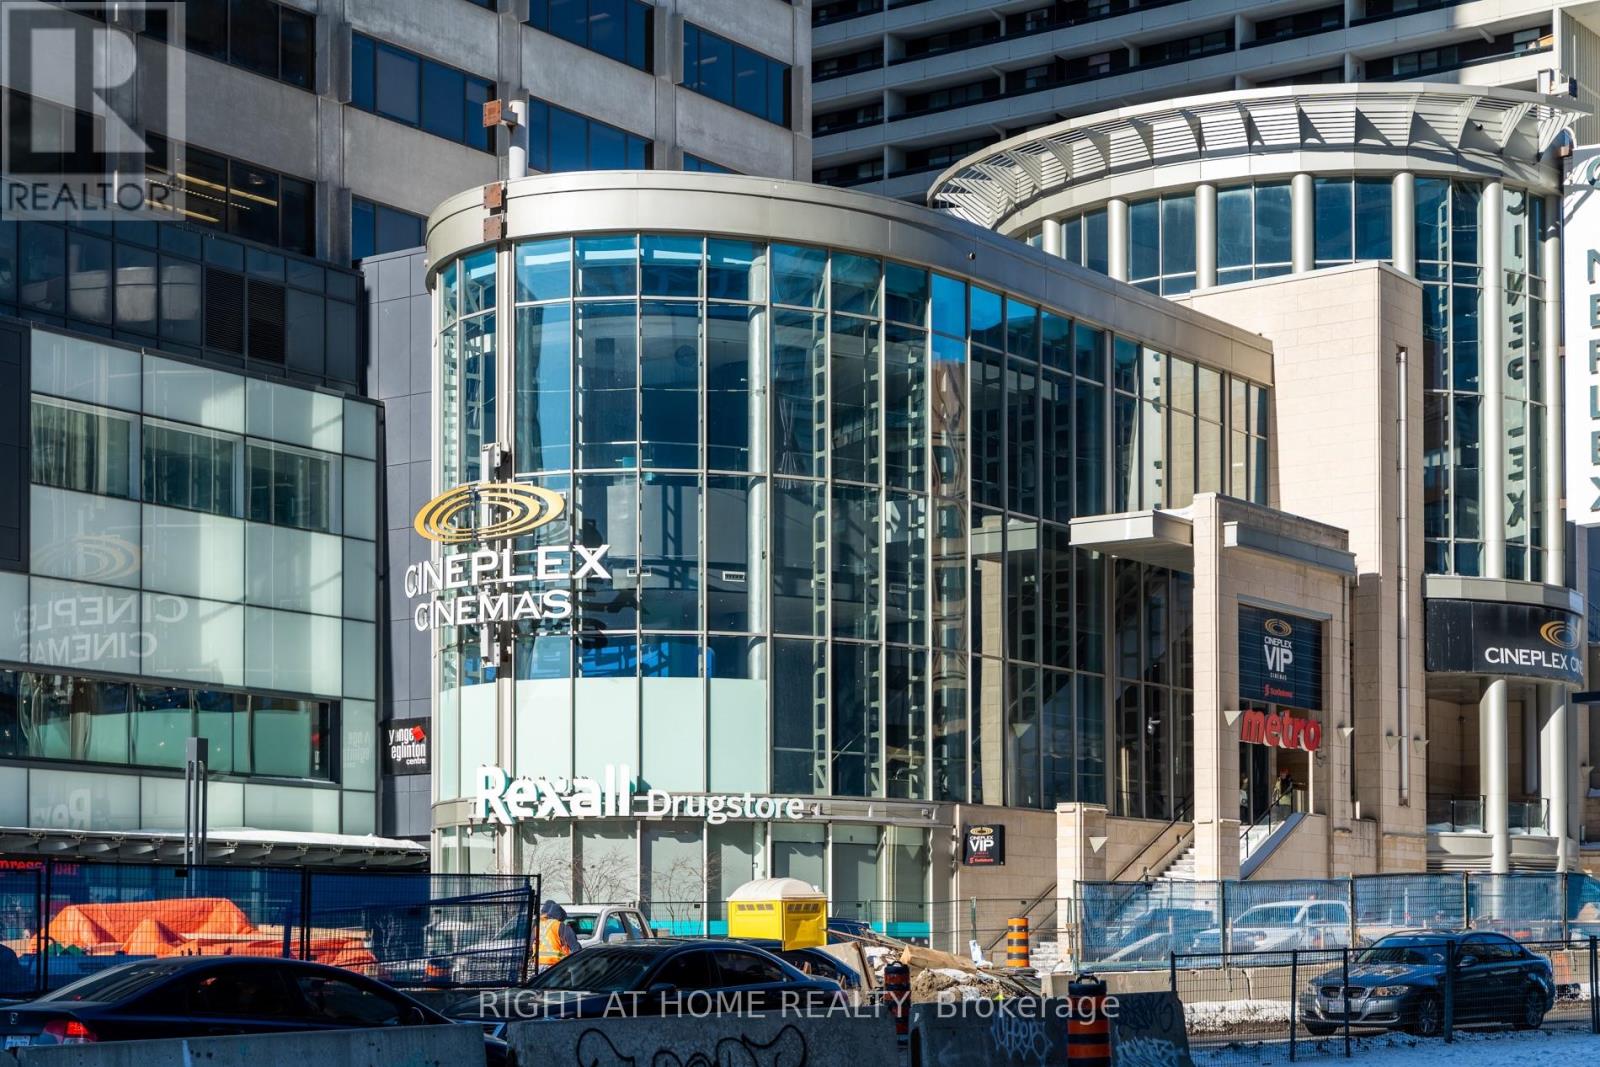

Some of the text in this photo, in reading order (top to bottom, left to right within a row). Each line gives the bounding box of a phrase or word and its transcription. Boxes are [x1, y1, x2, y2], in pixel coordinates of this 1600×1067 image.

[404, 544, 612, 599] CINEPLEX
[414, 589, 573, 632] CINEMAS
[1264, 636, 1292, 649] CINEPLEX
[1264, 644, 1293, 673] VIP
[1484, 647, 1568, 671] CINEPLEX
[1241, 709, 1322, 751] metro
[476, 763, 804, 824] Rexall Drugstore
[970, 840, 994, 851] VIP
